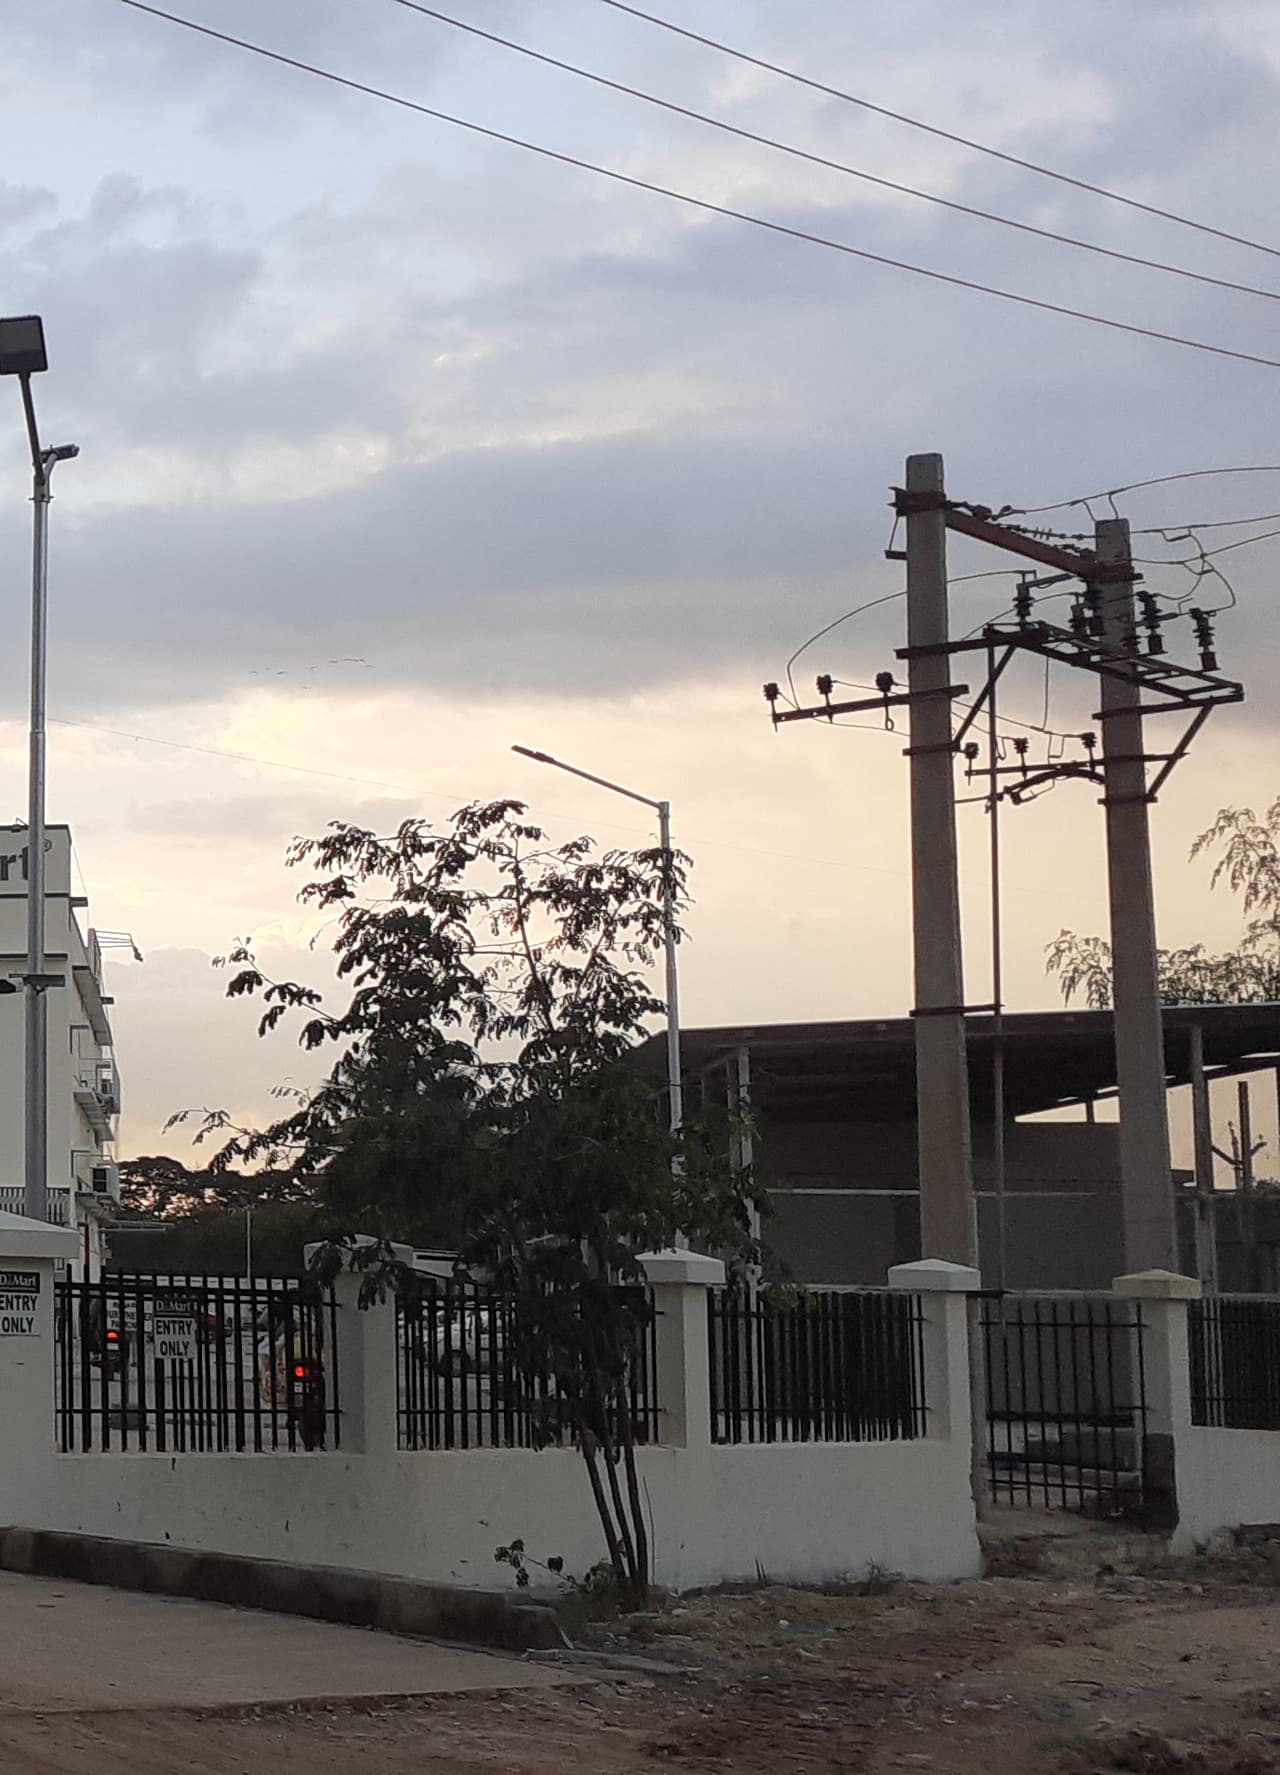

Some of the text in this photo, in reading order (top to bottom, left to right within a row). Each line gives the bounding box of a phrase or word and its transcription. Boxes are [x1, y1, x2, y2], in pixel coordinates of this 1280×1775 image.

[1, 1316, 35, 1333] ONLY
[156, 1319, 193, 1335] ENTRY
[159, 1340, 190, 1356] ONLY
